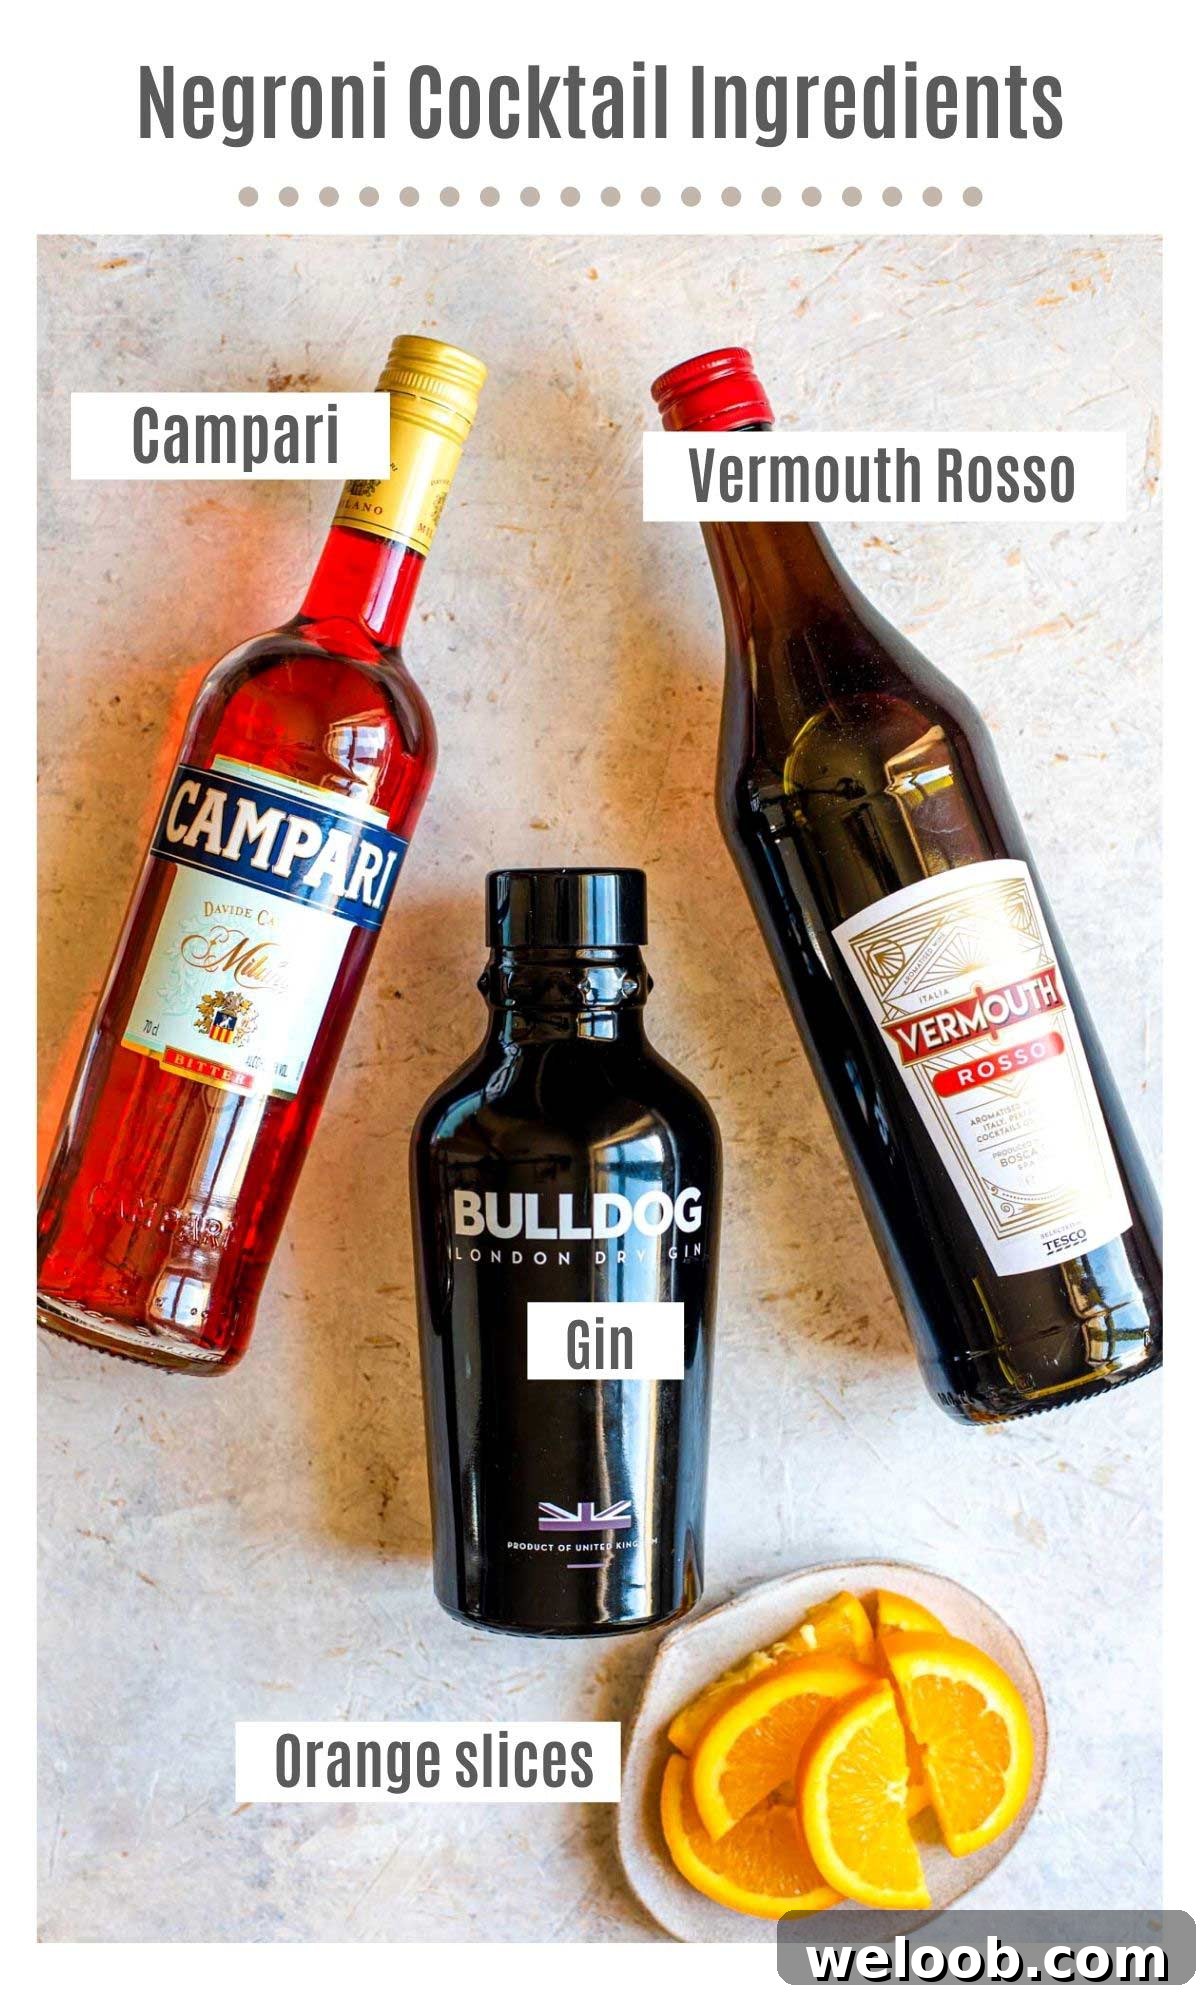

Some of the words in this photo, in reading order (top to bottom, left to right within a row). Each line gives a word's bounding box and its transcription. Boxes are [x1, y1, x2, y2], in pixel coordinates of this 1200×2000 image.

[165, 778, 399, 910] CAMPARI
[918, 988, 950, 1004] ITALIA
[142, 1018, 153, 1033] 70
[894, 975, 1061, 1054] VERMOUTH
[173, 1053, 250, 1087] BITTER
[957, 1040, 1047, 1087] ROSSO
[453, 1186, 703, 1240] BULLDOG
[454, 1248, 571, 1266] LONDON
[595, 1250, 648, 1265] DRY
[667, 1242, 702, 1260] GIN
[1042, 1228, 1088, 1251] TESCO
[506, 1541, 554, 1552] PRODUCT
[557, 1543, 572, 1552] OF
[575, 1542, 613, 1552] UNITED
